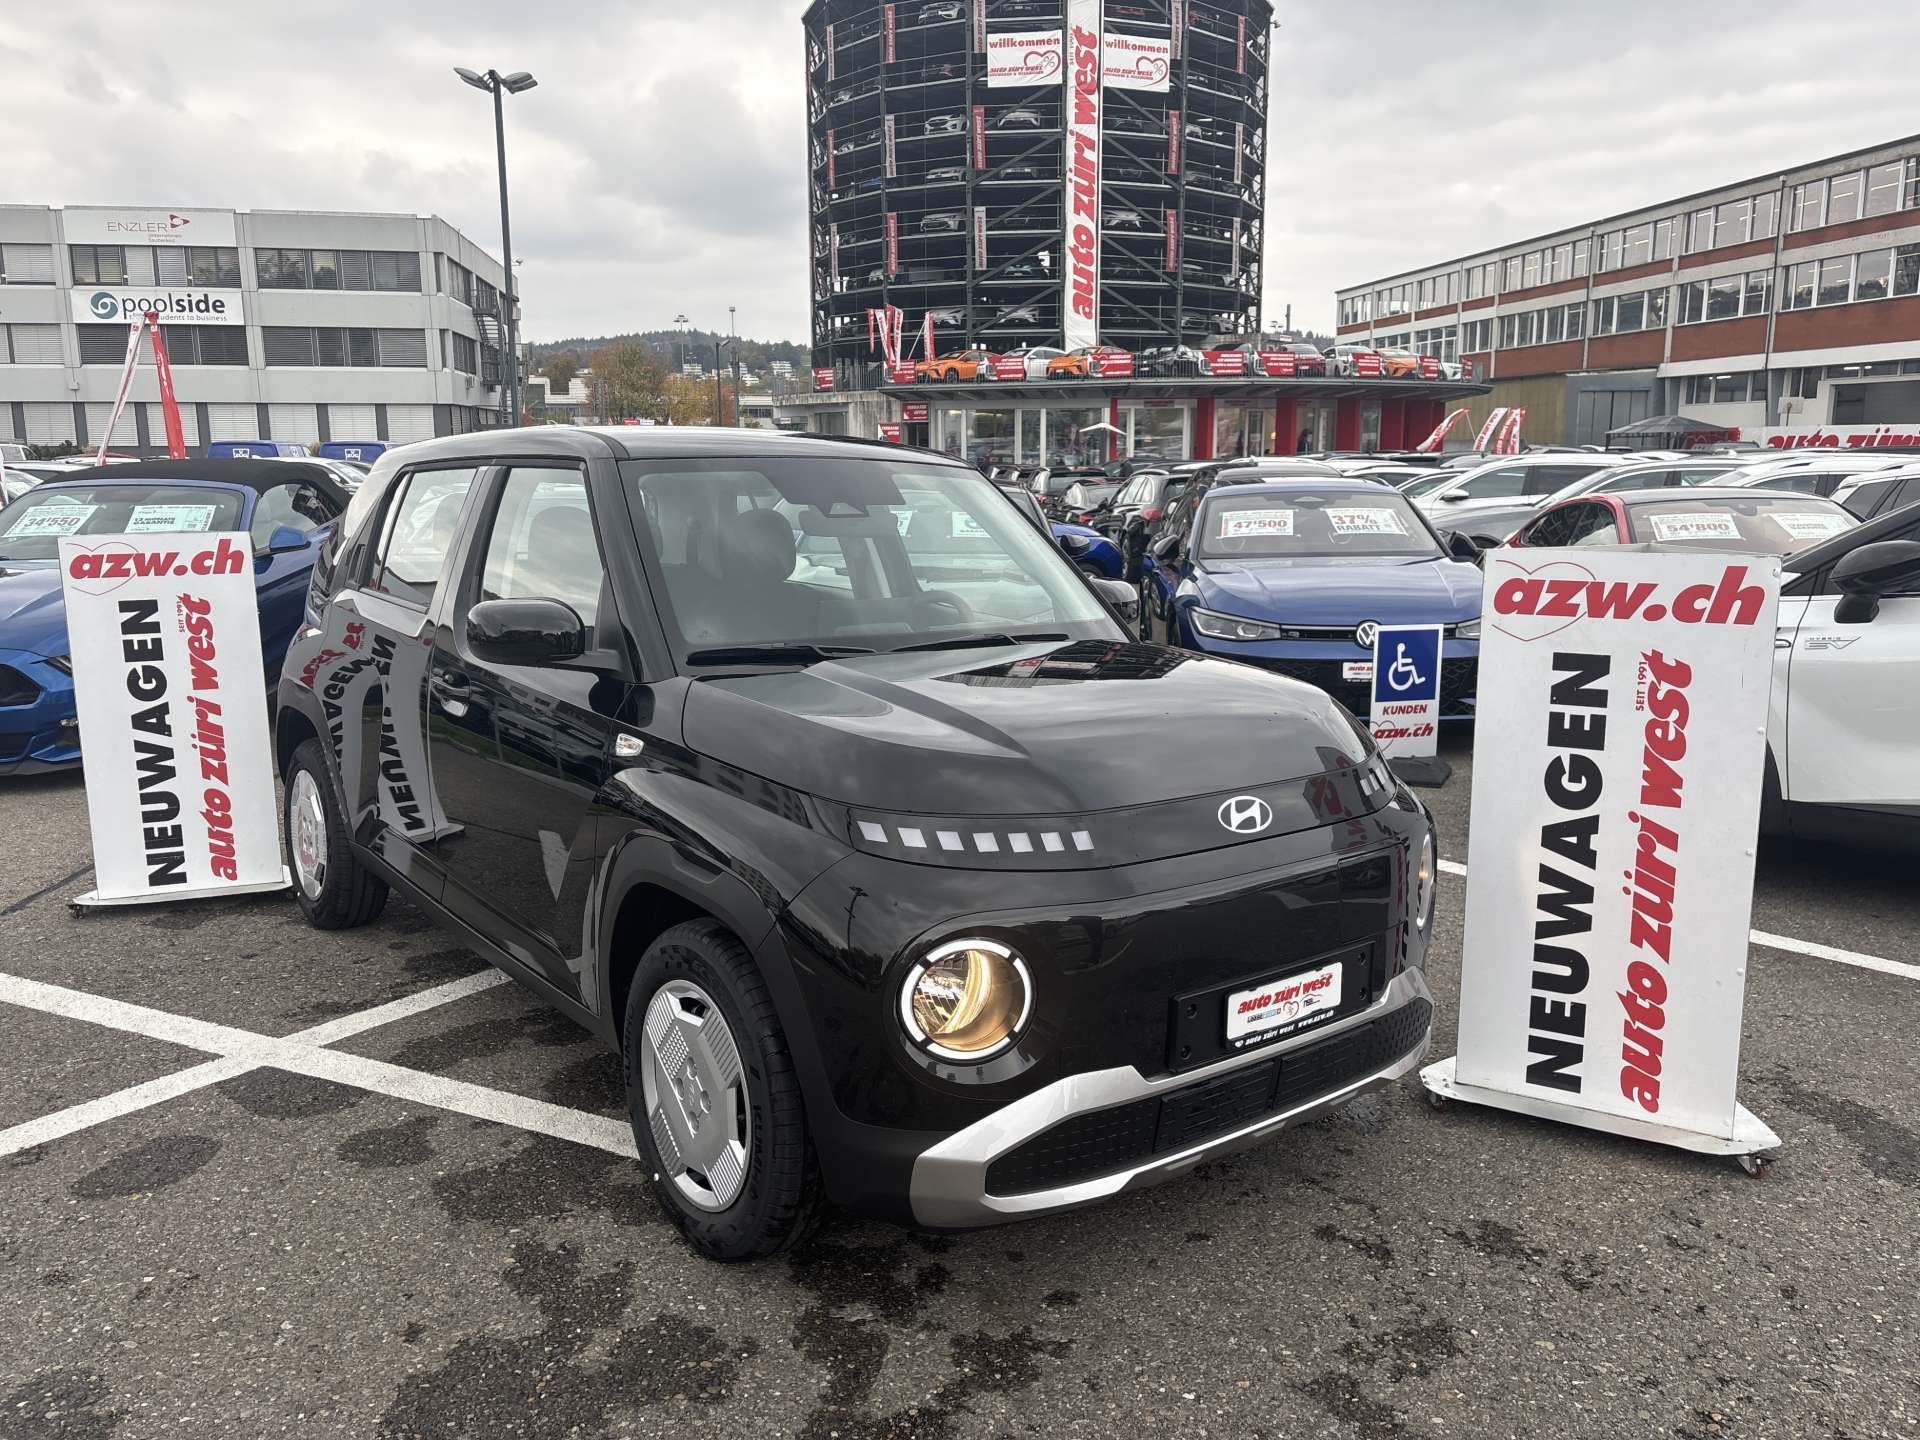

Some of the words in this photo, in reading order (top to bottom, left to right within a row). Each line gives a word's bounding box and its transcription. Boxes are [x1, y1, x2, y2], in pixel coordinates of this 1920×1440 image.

[989, 37, 1060, 49] willkommen
[1105, 39, 1168, 54] willkommen
[1072, 25, 1097, 124] west
[1067, 129, 1097, 224] züri
[107, 222, 168, 232] ENZLER
[1068, 223, 1096, 320] auto
[122, 292, 226, 320] poolside
[1767, 428, 1839, 448] auto
[24, 517, 80, 527] 34'550
[1234, 520, 1288, 528] 47'500
[1332, 514, 1378, 524] 37%
[70, 539, 244, 579] azw.ch
[1494, 566, 1765, 626] azw.ch
[176, 592, 219, 690] west
[1638, 662, 1648, 688] 1991
[1382, 704, 1428, 716] KUNDEN
[1636, 690, 1646, 711] SEIT
[118, 599, 188, 886] NEUWAGEN
[187, 696, 229, 786] züri
[1374, 723, 1434, 739] azw.ch
[1640, 648, 1692, 808] west
[199, 788, 238, 881] auto
[1526, 651, 1611, 1094] NEUWAGEN
[1622, 811, 1679, 964] züri
[1238, 992, 1272, 1014] auto
[1272, 982, 1302, 1005] züri
[1302, 972, 1334, 994] west
[1244, 1034, 1262, 1046] auto
[1262, 1028, 1278, 1040] züri
[1279, 1024, 1295, 1034] west
[1616, 961, 1668, 1114] auto
